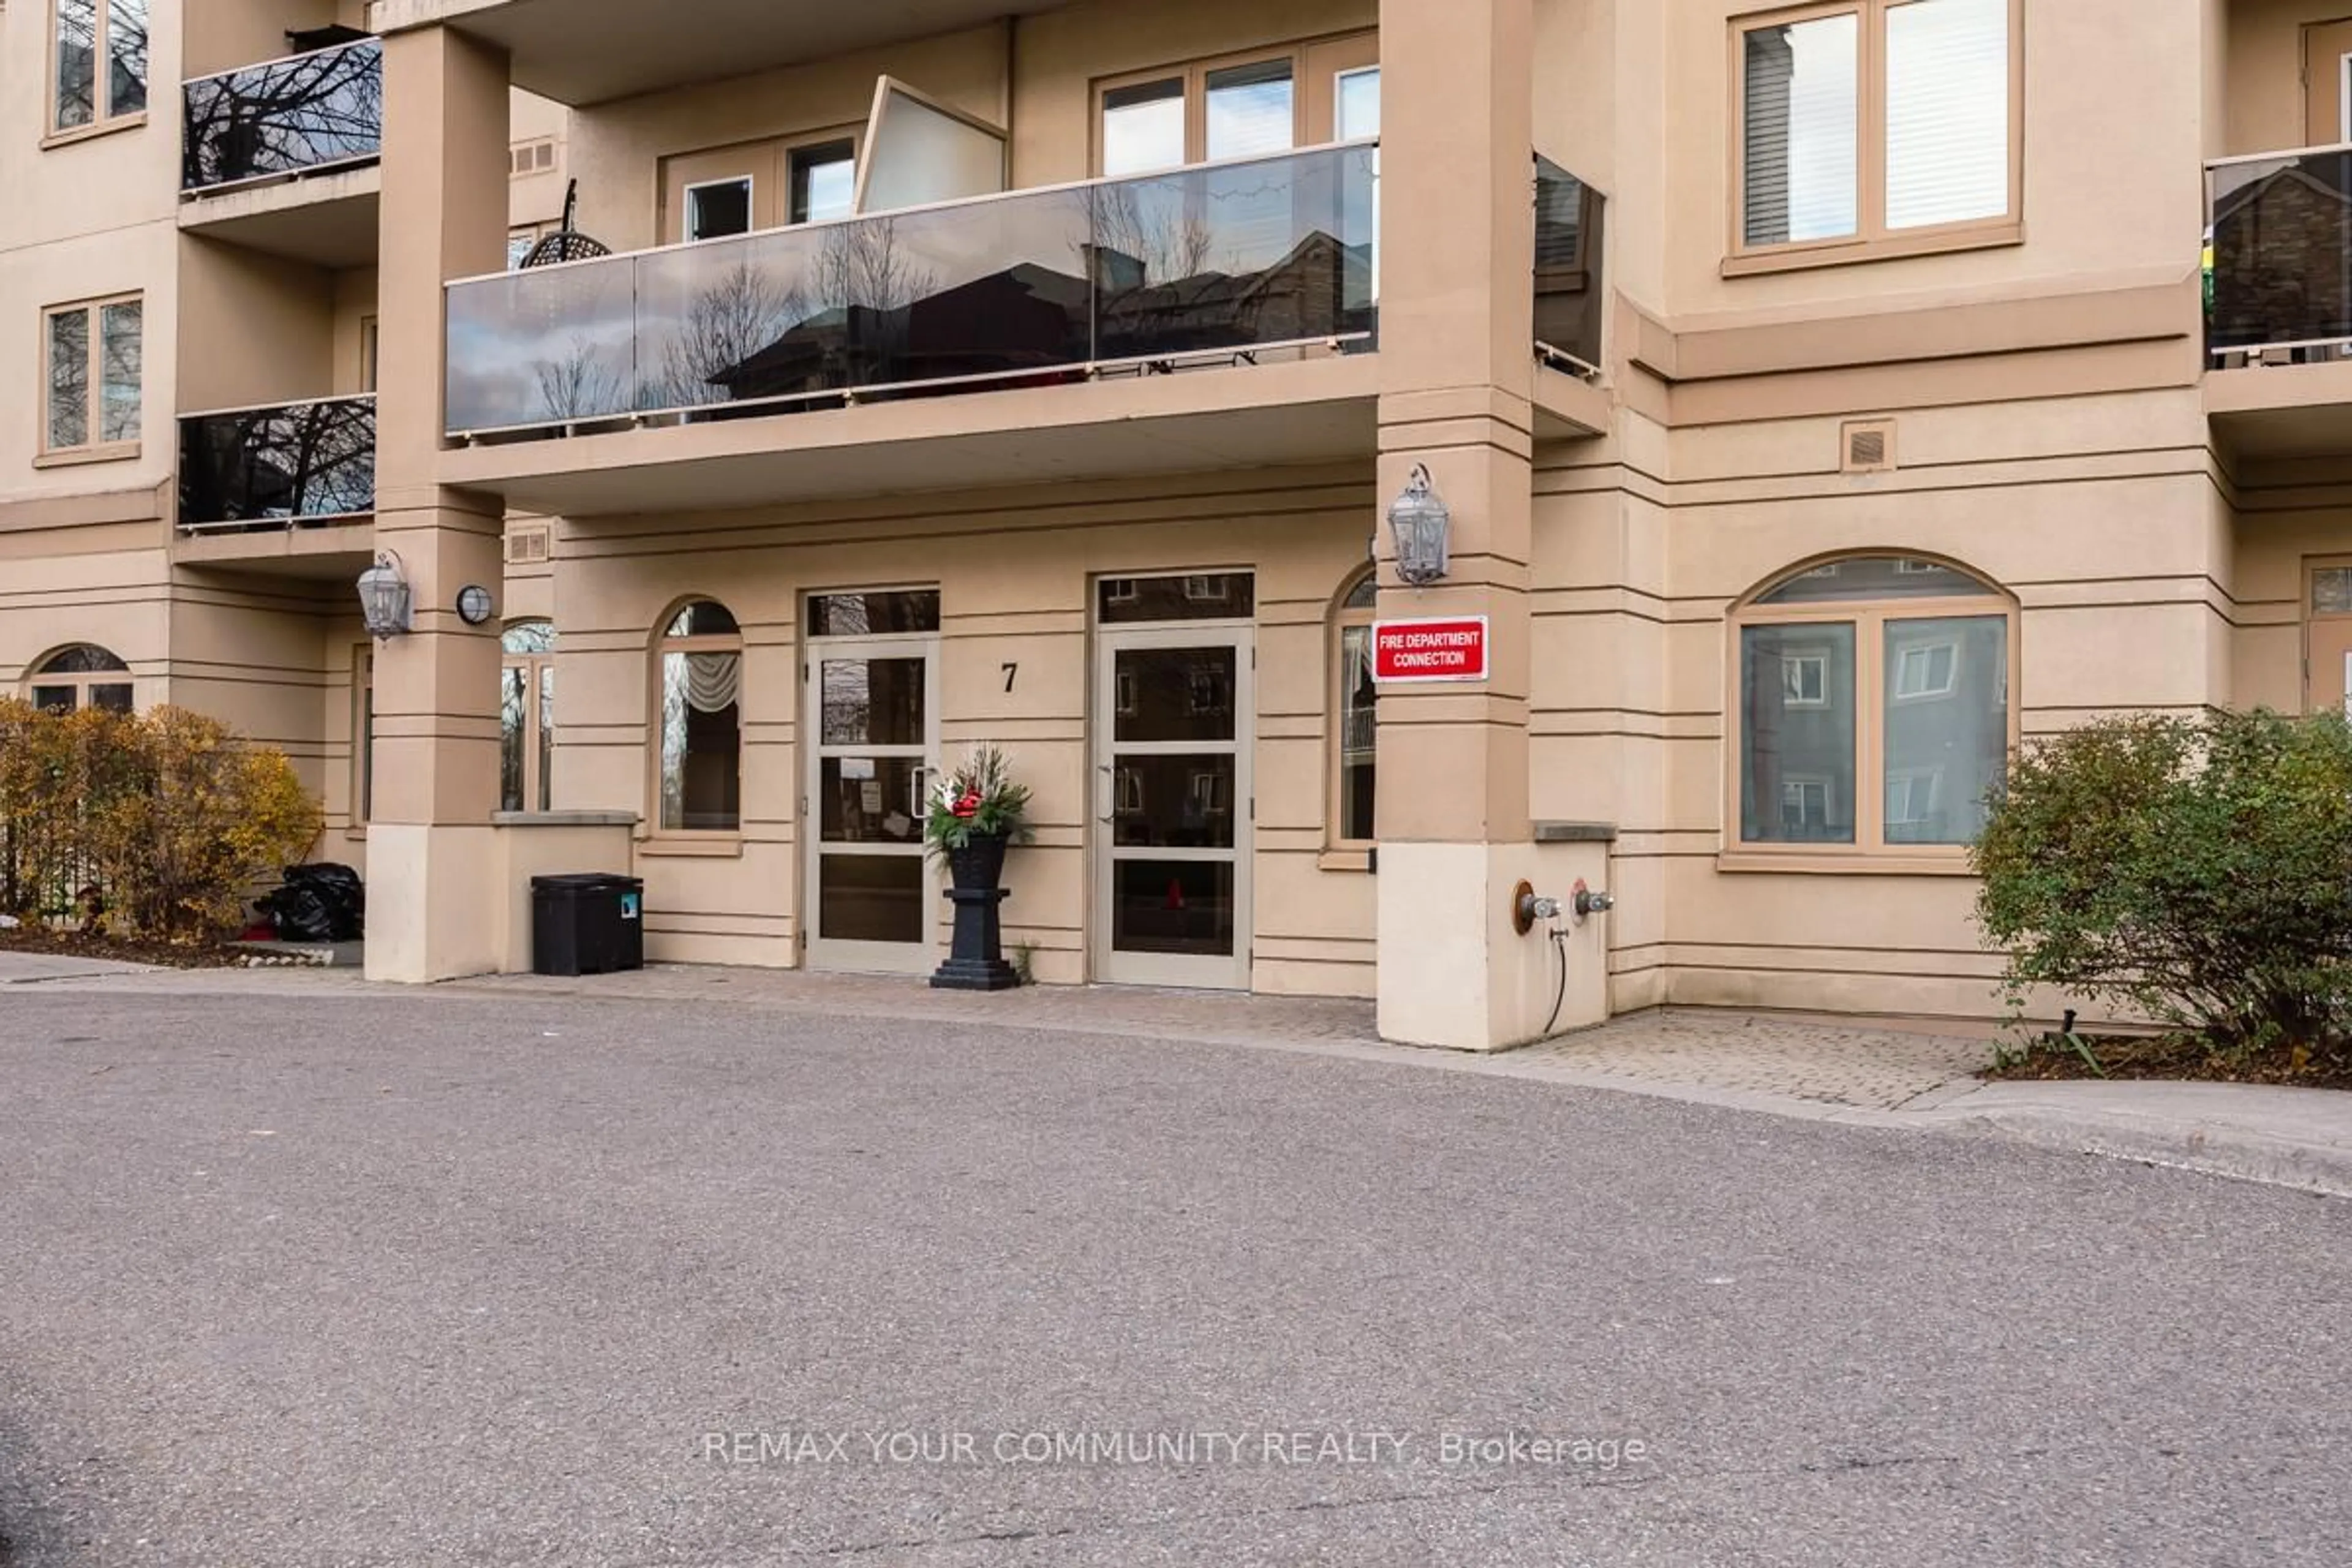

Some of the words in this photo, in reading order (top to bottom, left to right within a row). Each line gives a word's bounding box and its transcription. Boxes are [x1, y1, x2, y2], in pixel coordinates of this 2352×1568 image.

[1379, 635, 1404, 649] FIRE
[1406, 631, 1480, 648] DEPARTMENT
[1393, 651, 1465, 667] CONNECTION
[1002, 663, 1017, 692] 7
